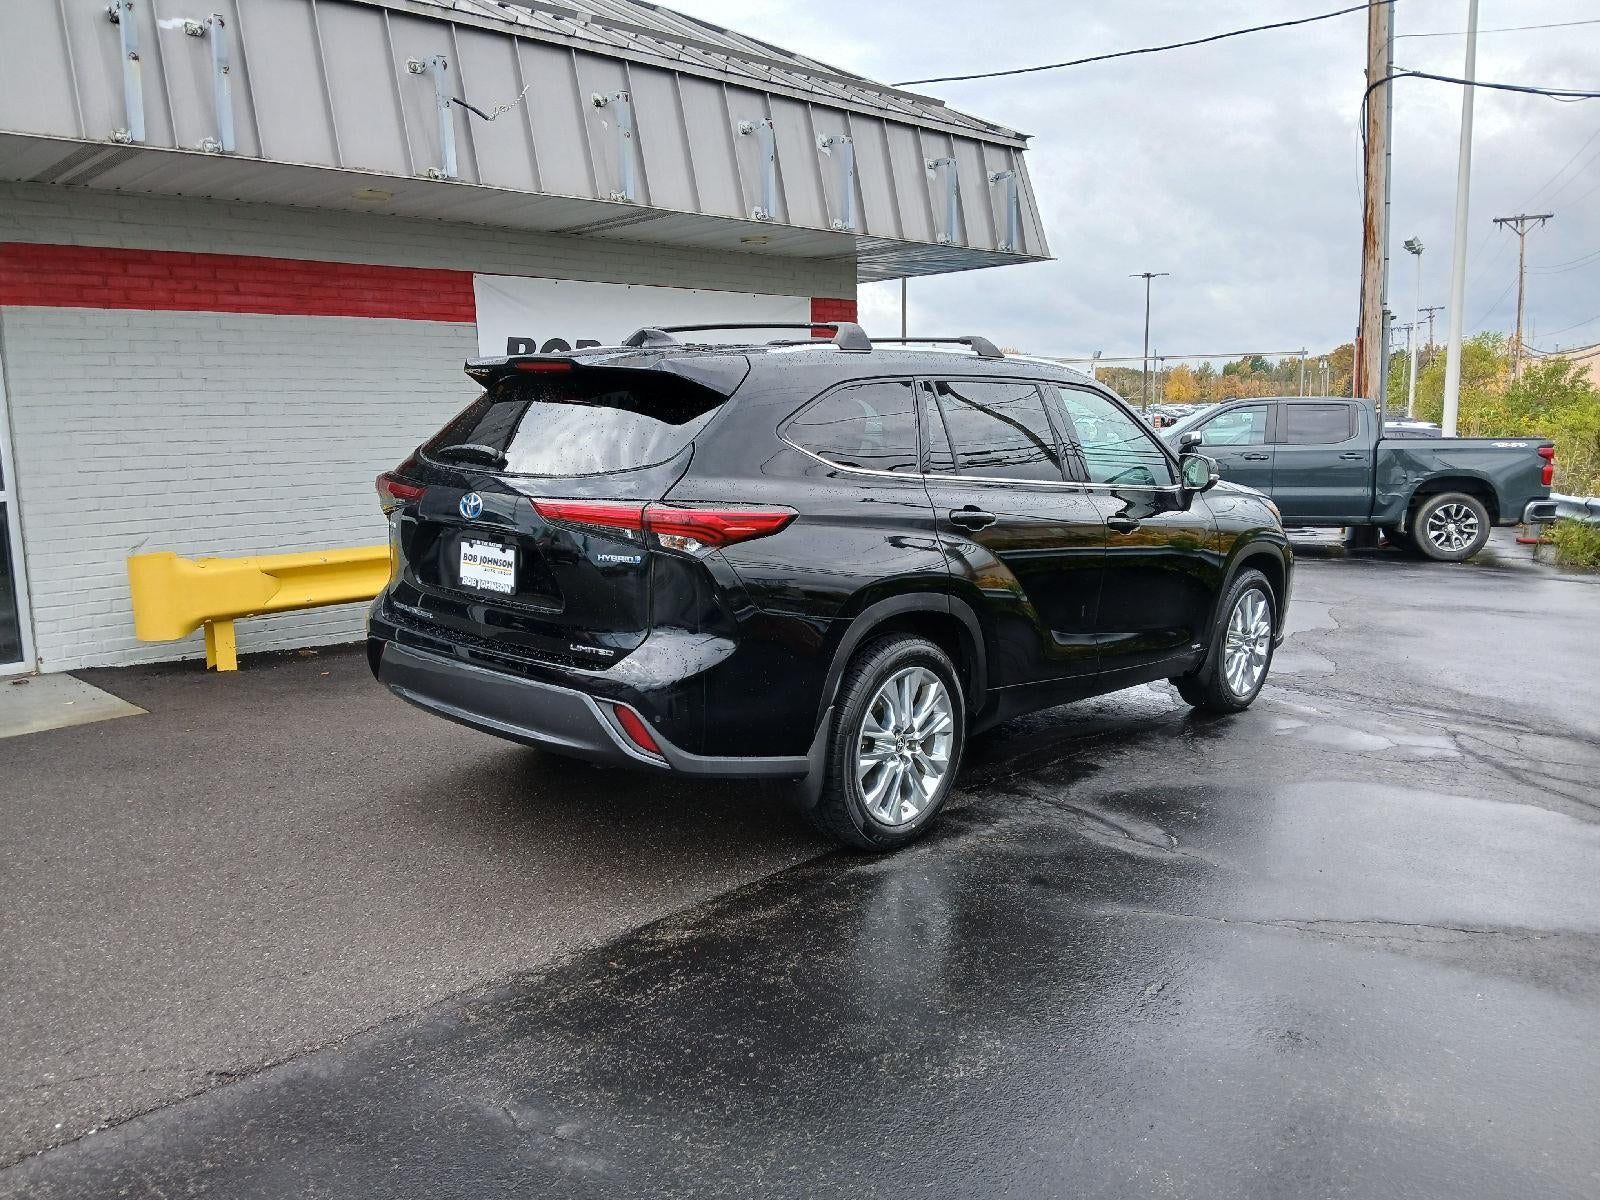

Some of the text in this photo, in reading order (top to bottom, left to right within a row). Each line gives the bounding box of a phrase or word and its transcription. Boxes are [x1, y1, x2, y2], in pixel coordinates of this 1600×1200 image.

[463, 552, 514, 569] BOB JOHNSON
[597, 554, 634, 564] HYBRID
[462, 575, 512, 594] BOB JOHNSON
[569, 643, 615, 657] LIMITED
